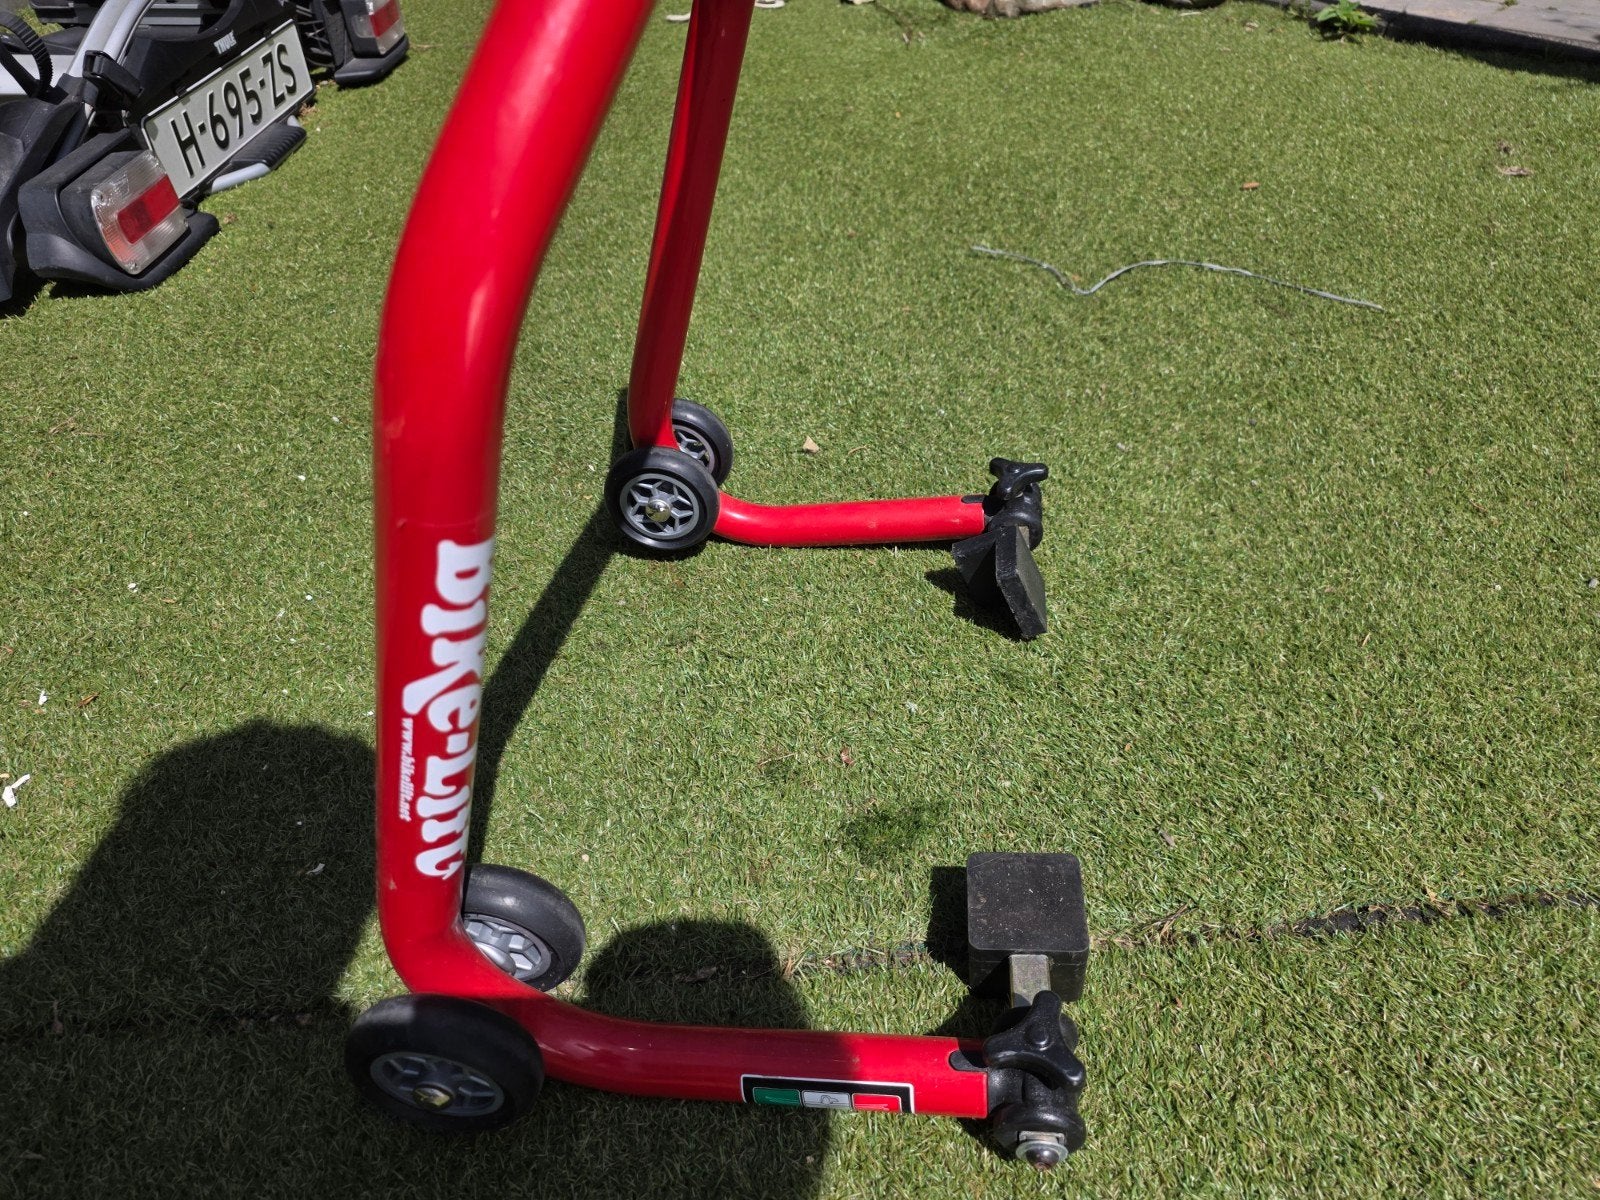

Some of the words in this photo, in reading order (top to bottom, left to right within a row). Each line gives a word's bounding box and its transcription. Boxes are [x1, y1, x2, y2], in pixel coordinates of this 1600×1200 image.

[213, 29, 237, 54] THULE
[169, 43, 297, 178] H-695-ZS
[399, 717, 416, 822] www.bikelift.net
